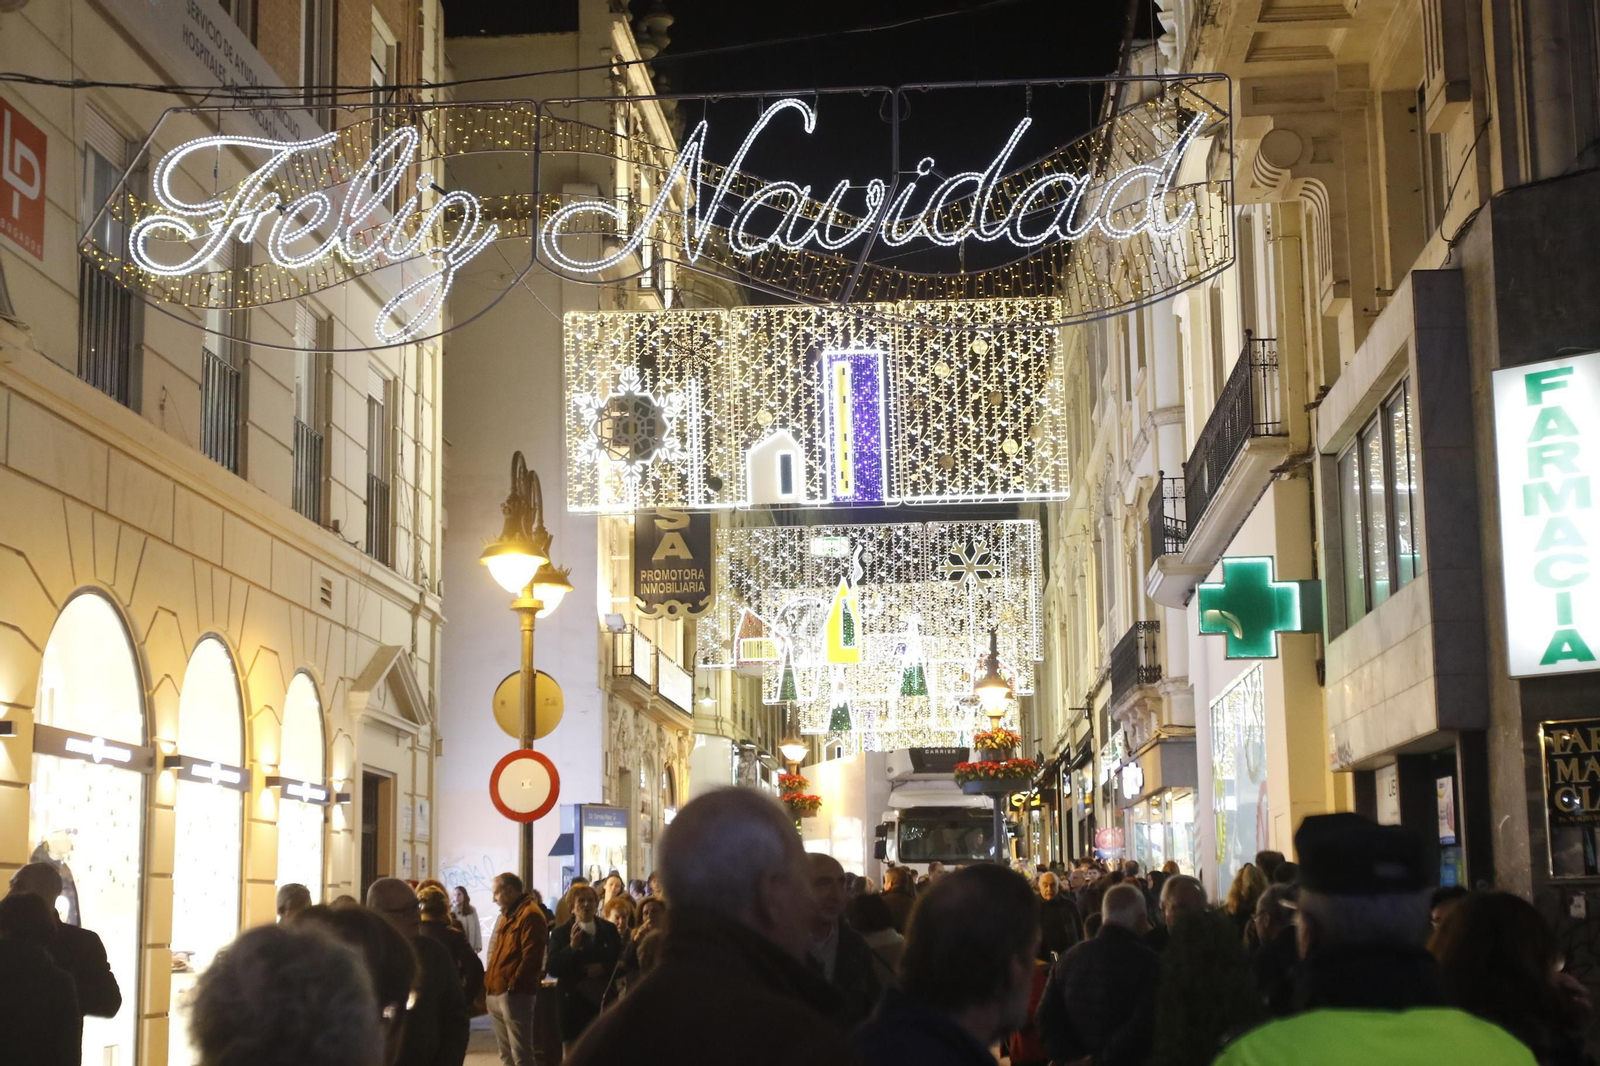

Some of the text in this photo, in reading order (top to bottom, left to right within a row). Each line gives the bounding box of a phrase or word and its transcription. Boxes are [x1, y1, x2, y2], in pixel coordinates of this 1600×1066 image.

[223, 38, 234, 64] DE
[128, 125, 499, 345] Feliz
[539, 97, 1209, 274] Navidad
[1522, 366, 1598, 667] FARMACIA
[640, 568, 706, 582] PROMOTORA
[640, 581, 706, 595] INMOBILIARIA
[1554, 784, 1600, 813] CI
